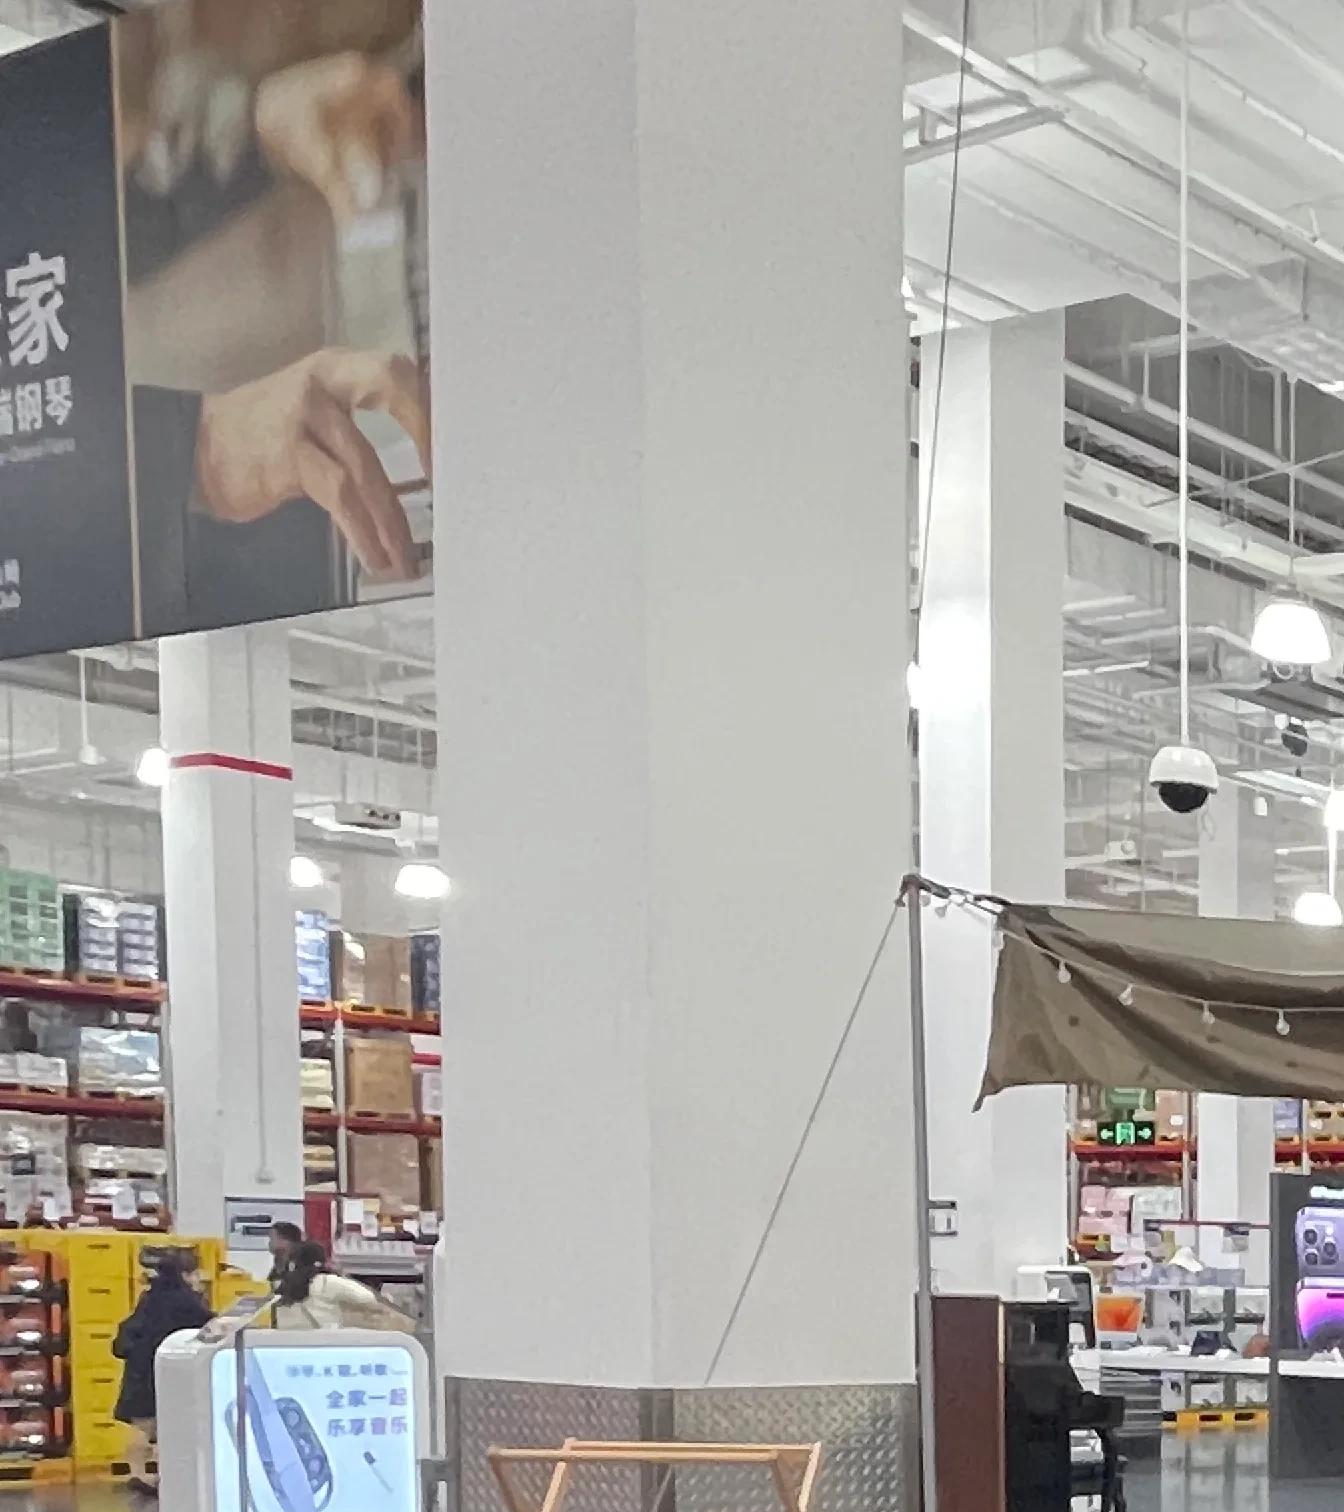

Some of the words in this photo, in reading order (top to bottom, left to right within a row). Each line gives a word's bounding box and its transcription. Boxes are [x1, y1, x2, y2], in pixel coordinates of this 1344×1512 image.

[5, 252, 70, 367] 家
[326, 1387, 408, 1409] 全家一起
[327, 1416, 408, 1437] 乐享音乐
